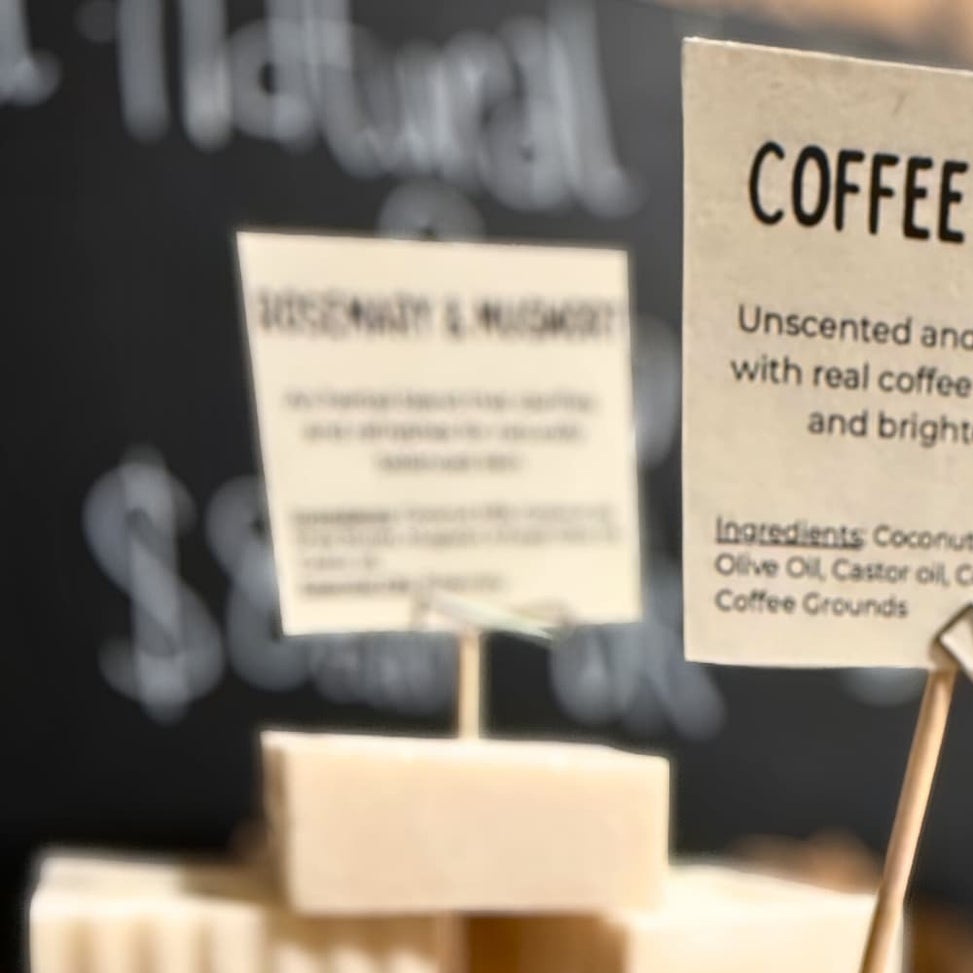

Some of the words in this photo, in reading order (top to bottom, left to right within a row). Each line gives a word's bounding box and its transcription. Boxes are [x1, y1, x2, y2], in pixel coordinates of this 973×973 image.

[749, 141, 969, 244] COFFEE
[738, 303, 913, 347] Unscented
[731, 354, 803, 386] with
[813, 362, 870, 391] real
[877, 365, 972, 399] coffee
[808, 408, 868, 438] and
[715, 553, 779, 577] Olive
[786, 555, 826, 582] Oil,
[832, 557, 909, 583] Castor
[915, 561, 950, 587] oil,
[715, 588, 796, 614] Coffee
[803, 592, 909, 618] Grounds
